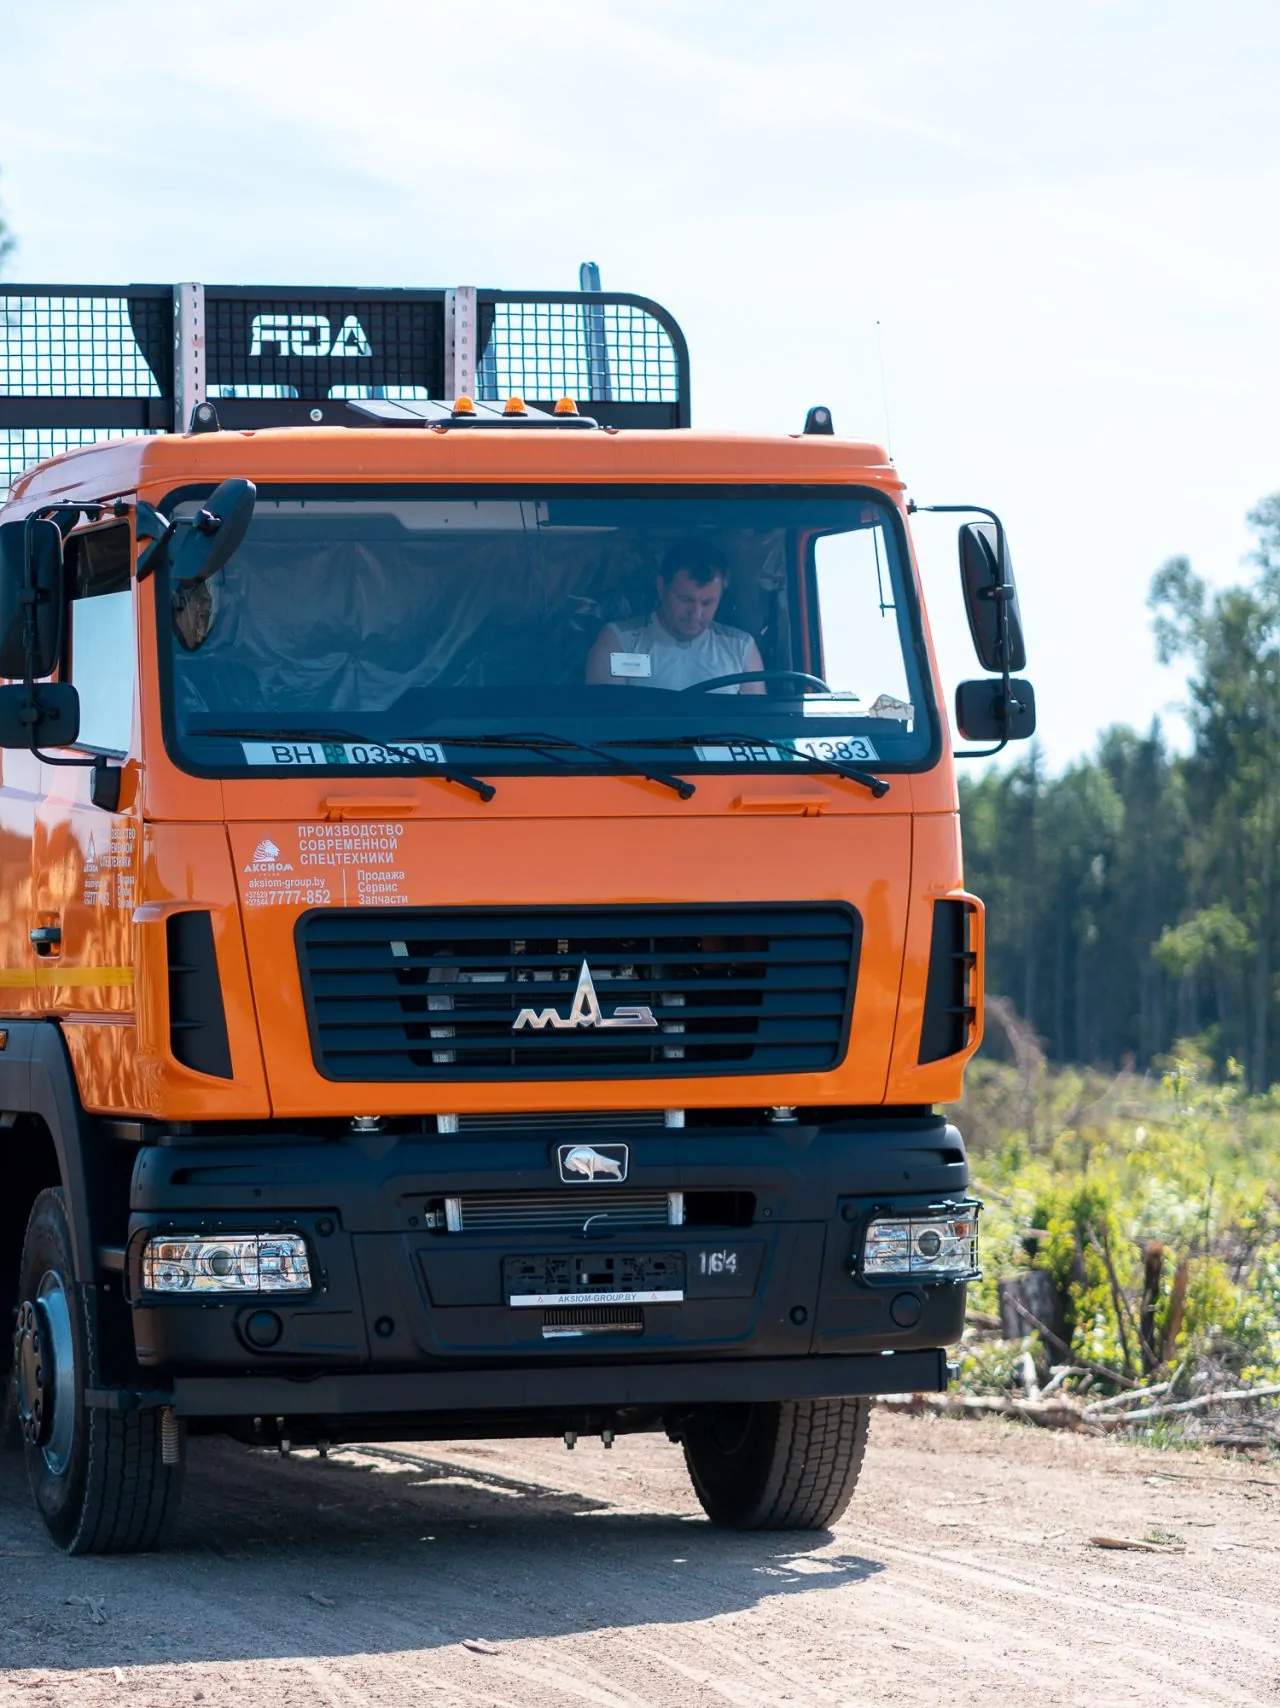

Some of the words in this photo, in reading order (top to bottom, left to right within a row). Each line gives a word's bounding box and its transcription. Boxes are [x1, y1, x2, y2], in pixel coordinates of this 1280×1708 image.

[271, 745, 317, 764] BH
[729, 746, 771, 762] BH
[805, 741, 870, 760] 1383
[298, 824, 404, 838] ПРОИЗВОДСТВО
[299, 836, 398, 851] СОВРЕМЕННОЙ
[300, 852, 394, 866] СПЕЦТЕХНИКИ
[248, 876, 326, 889] aksiom-group.by
[357, 869, 405, 882] Продажа
[358, 881, 398, 894] Сервис
[268, 889, 331, 905] 7777-852
[358, 894, 408, 906] Запчасти
[558, 1293, 637, 1303] AKSIOM-GROUP.BY
